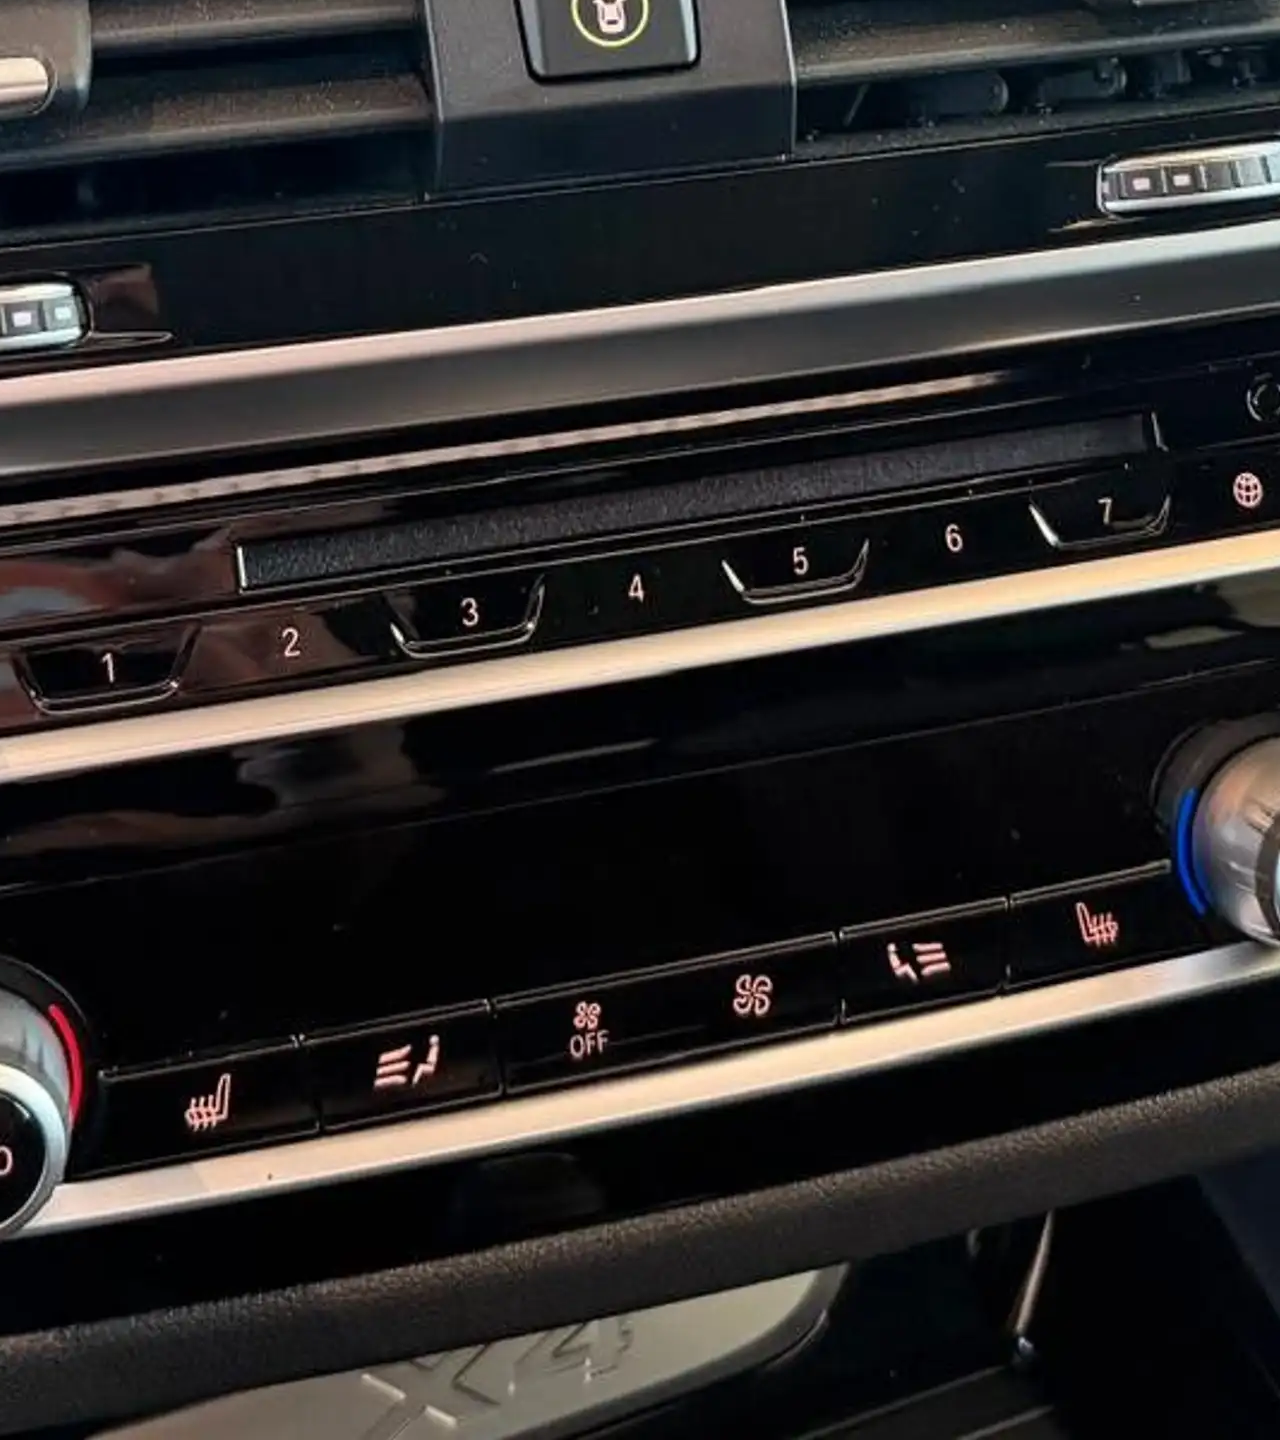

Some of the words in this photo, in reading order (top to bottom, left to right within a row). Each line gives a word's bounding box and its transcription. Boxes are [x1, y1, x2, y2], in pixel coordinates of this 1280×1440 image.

[1098, 498, 1112, 524] 7
[945, 524, 962, 552] 6
[793, 547, 808, 575] 5
[627, 574, 644, 601] 4
[461, 597, 480, 626] 3
[283, 628, 301, 657] 2
[101, 653, 114, 684] 1
[569, 1029, 609, 1058] OFF
